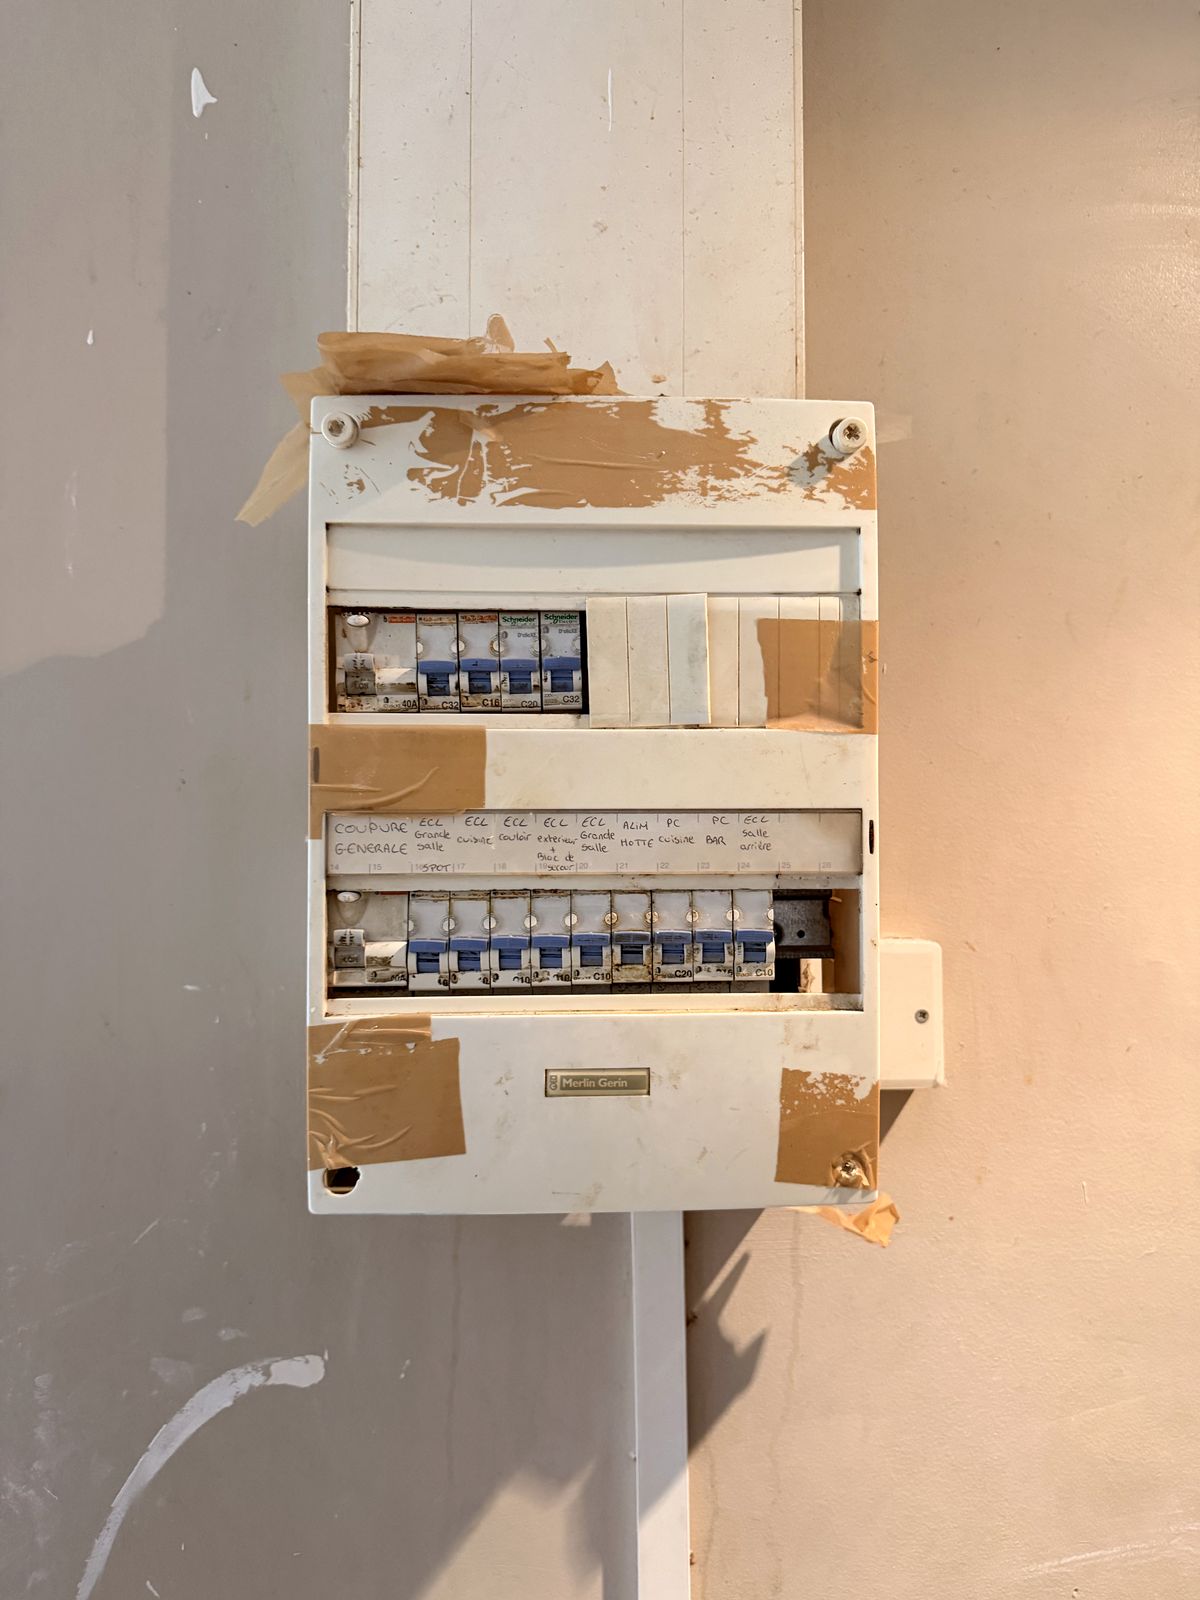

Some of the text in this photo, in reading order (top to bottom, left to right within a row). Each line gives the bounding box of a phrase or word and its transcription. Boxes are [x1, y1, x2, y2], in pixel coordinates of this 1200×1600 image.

[502, 615, 536, 626] Schneider
[544, 613, 578, 624] Schneider
[401, 699, 418, 709] 40A
[482, 698, 500, 708] C16
[520, 700, 538, 709] C20
[562, 695, 580, 704] C32
[441, 700, 459, 710] C32
[419, 817, 443, 827] ECL
[465, 816, 489, 827] ECL
[503, 816, 528, 827] ECL
[543, 817, 568, 828] ECL
[581, 816, 606, 827] ECL
[667, 818, 680, 828] PC
[712, 815, 731, 825] PC
[743, 815, 769, 825] ECL
[334, 822, 408, 834] COUPURE
[499, 831, 532, 841] couloir
[580, 828, 615, 840] Grande
[620, 838, 654, 848] HOTTE
[706, 834, 727, 846] BAR
[335, 842, 408, 855] GENERALE
[565, 852, 575, 862] de
[373, 863, 382, 871] 15
[578, 862, 588, 870] 20
[593, 972, 611, 981] C10
[674, 969, 692, 978] C20
[755, 968, 773, 976] C10
[562, 1078, 595, 1088] Merlin
[598, 1078, 628, 1088] Gerin
